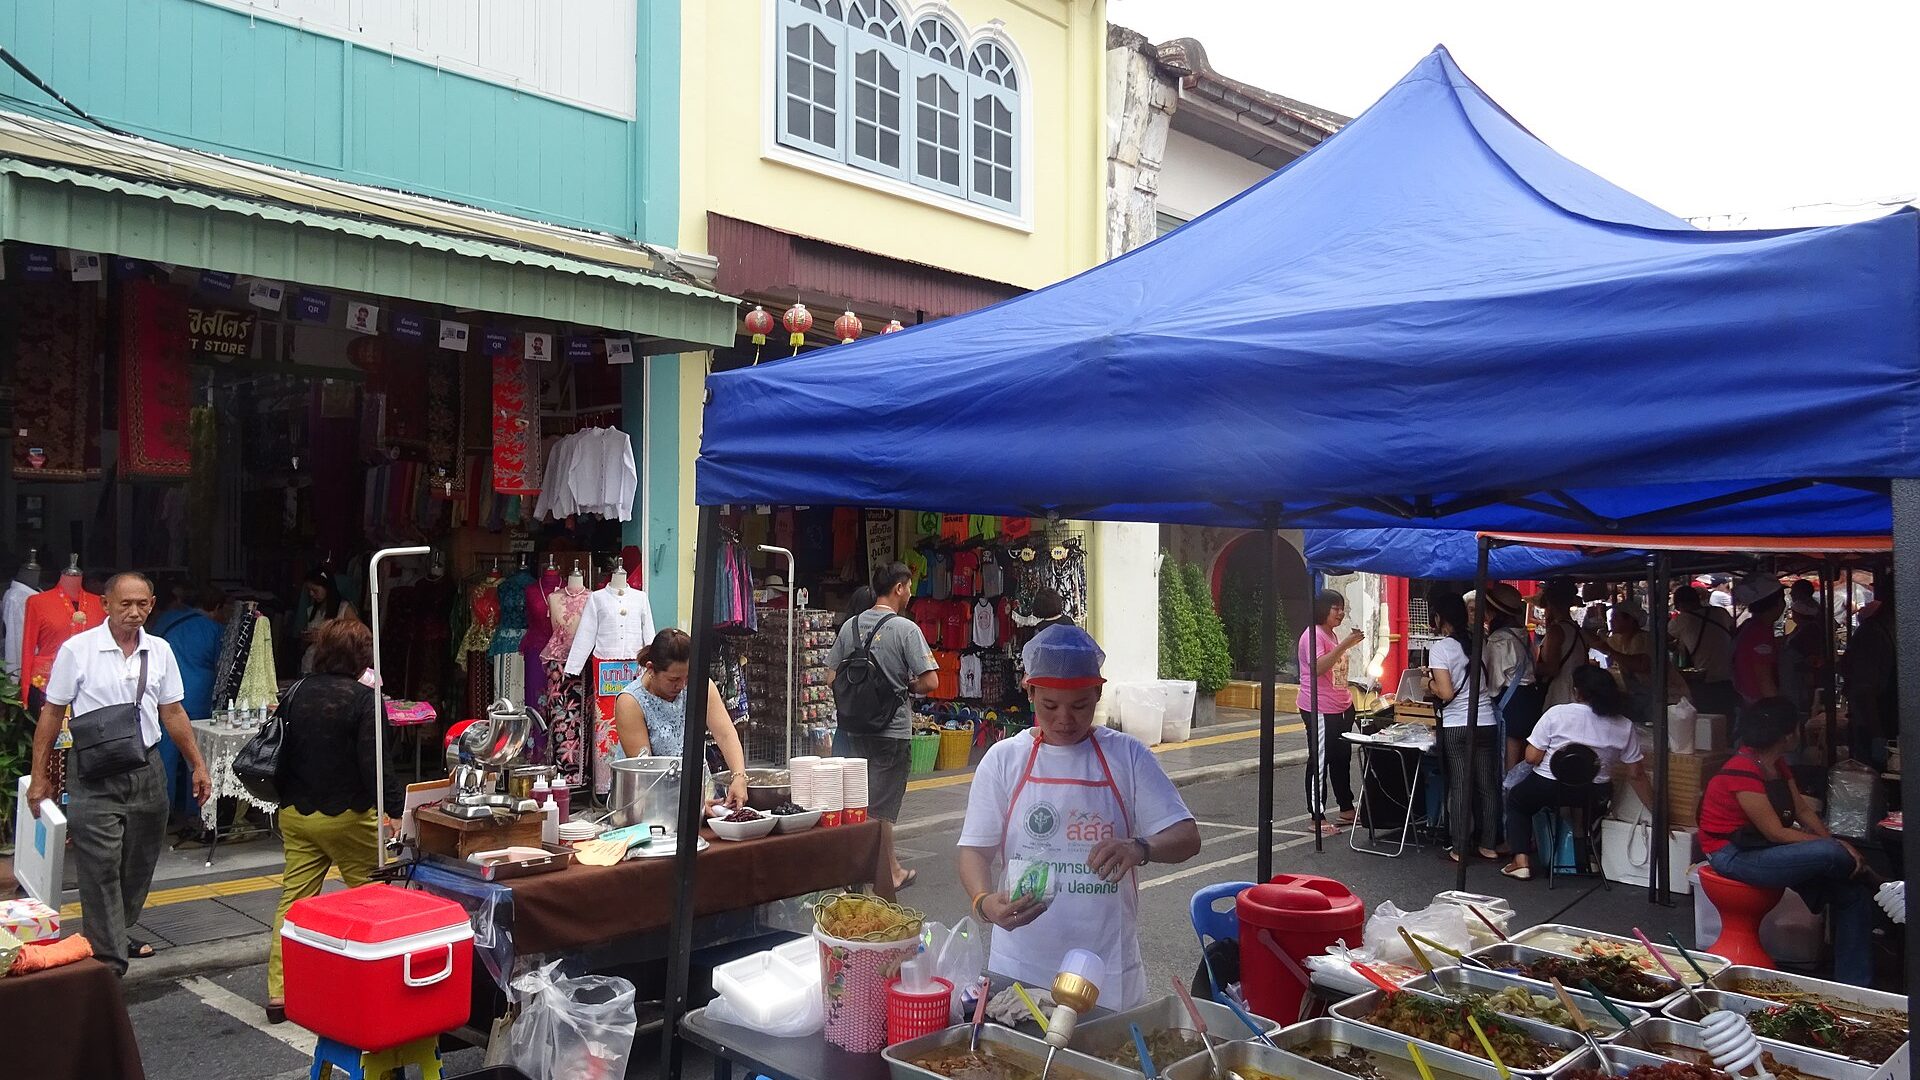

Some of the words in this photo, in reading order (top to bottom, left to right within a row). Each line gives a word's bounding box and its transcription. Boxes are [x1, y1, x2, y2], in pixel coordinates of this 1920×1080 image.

[307, 304, 319, 313] QR
[204, 339, 246, 355] STORE
[492, 341, 502, 350] QR
[1068, 879, 1118, 893] ปลอดภัย
